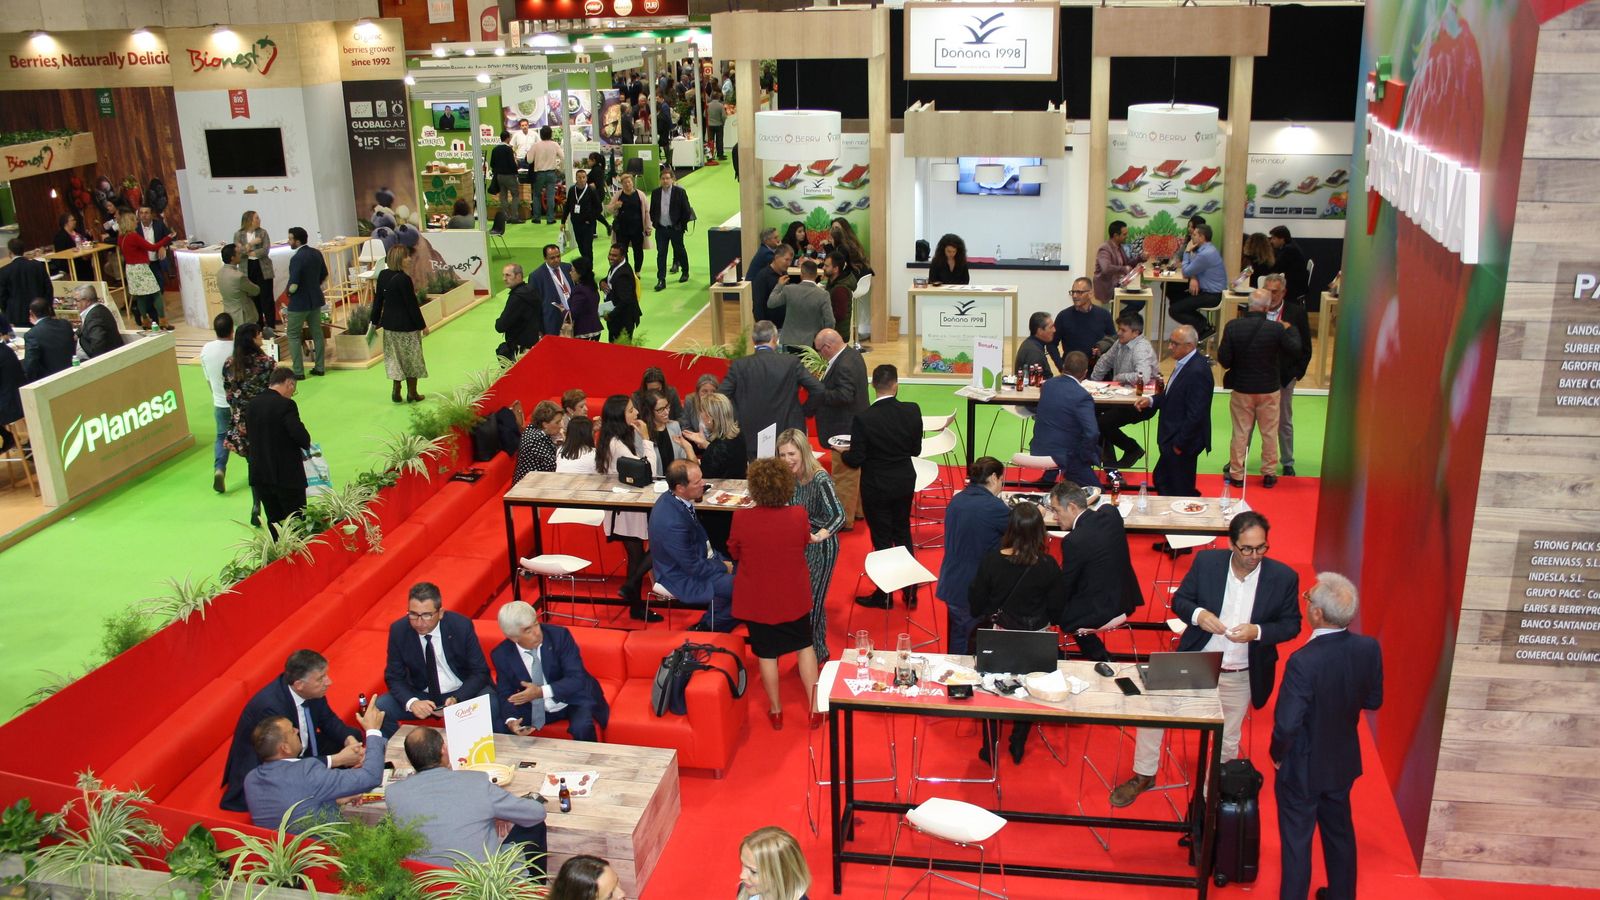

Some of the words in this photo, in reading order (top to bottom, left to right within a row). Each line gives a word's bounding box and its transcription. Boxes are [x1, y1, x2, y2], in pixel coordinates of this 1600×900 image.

[343, 45, 368, 53] berries
[369, 45, 395, 55] grower
[941, 48, 990, 58] Doñana
[996, 48, 1020, 58] 1998
[9, 55, 60, 69] Berries,
[62, 52, 125, 69] Naturally
[186, 44, 259, 72] Bionest
[352, 58, 371, 66] since
[372, 57, 390, 65] 1992
[364, 136, 380, 146] IFS
[5, 150, 44, 172] Bionest
[430, 257, 471, 272] Bionest
[943, 315, 968, 323] Doñana
[1559, 378, 1588, 389] BAYER
[84, 389, 178, 453] Planasa
[1533, 540, 1569, 551] STRONG
[1571, 541, 1595, 552] PACK
[1531, 556, 1583, 568] GREENVASS,
[1528, 572, 1567, 583] INDESLA,
[1569, 573, 1585, 583] S.L.
[1526, 587, 1557, 598] GRUPO
[1558, 589, 1581, 599] PACC
[1523, 603, 1548, 613] EARIS
[1549, 604, 1557, 613] &
[1521, 619, 1551, 629] BANCO
[1518, 635, 1559, 646] REGABER,
[1561, 636, 1578, 646] S.A.
[1515, 650, 1565, 661] COMERCIAL
